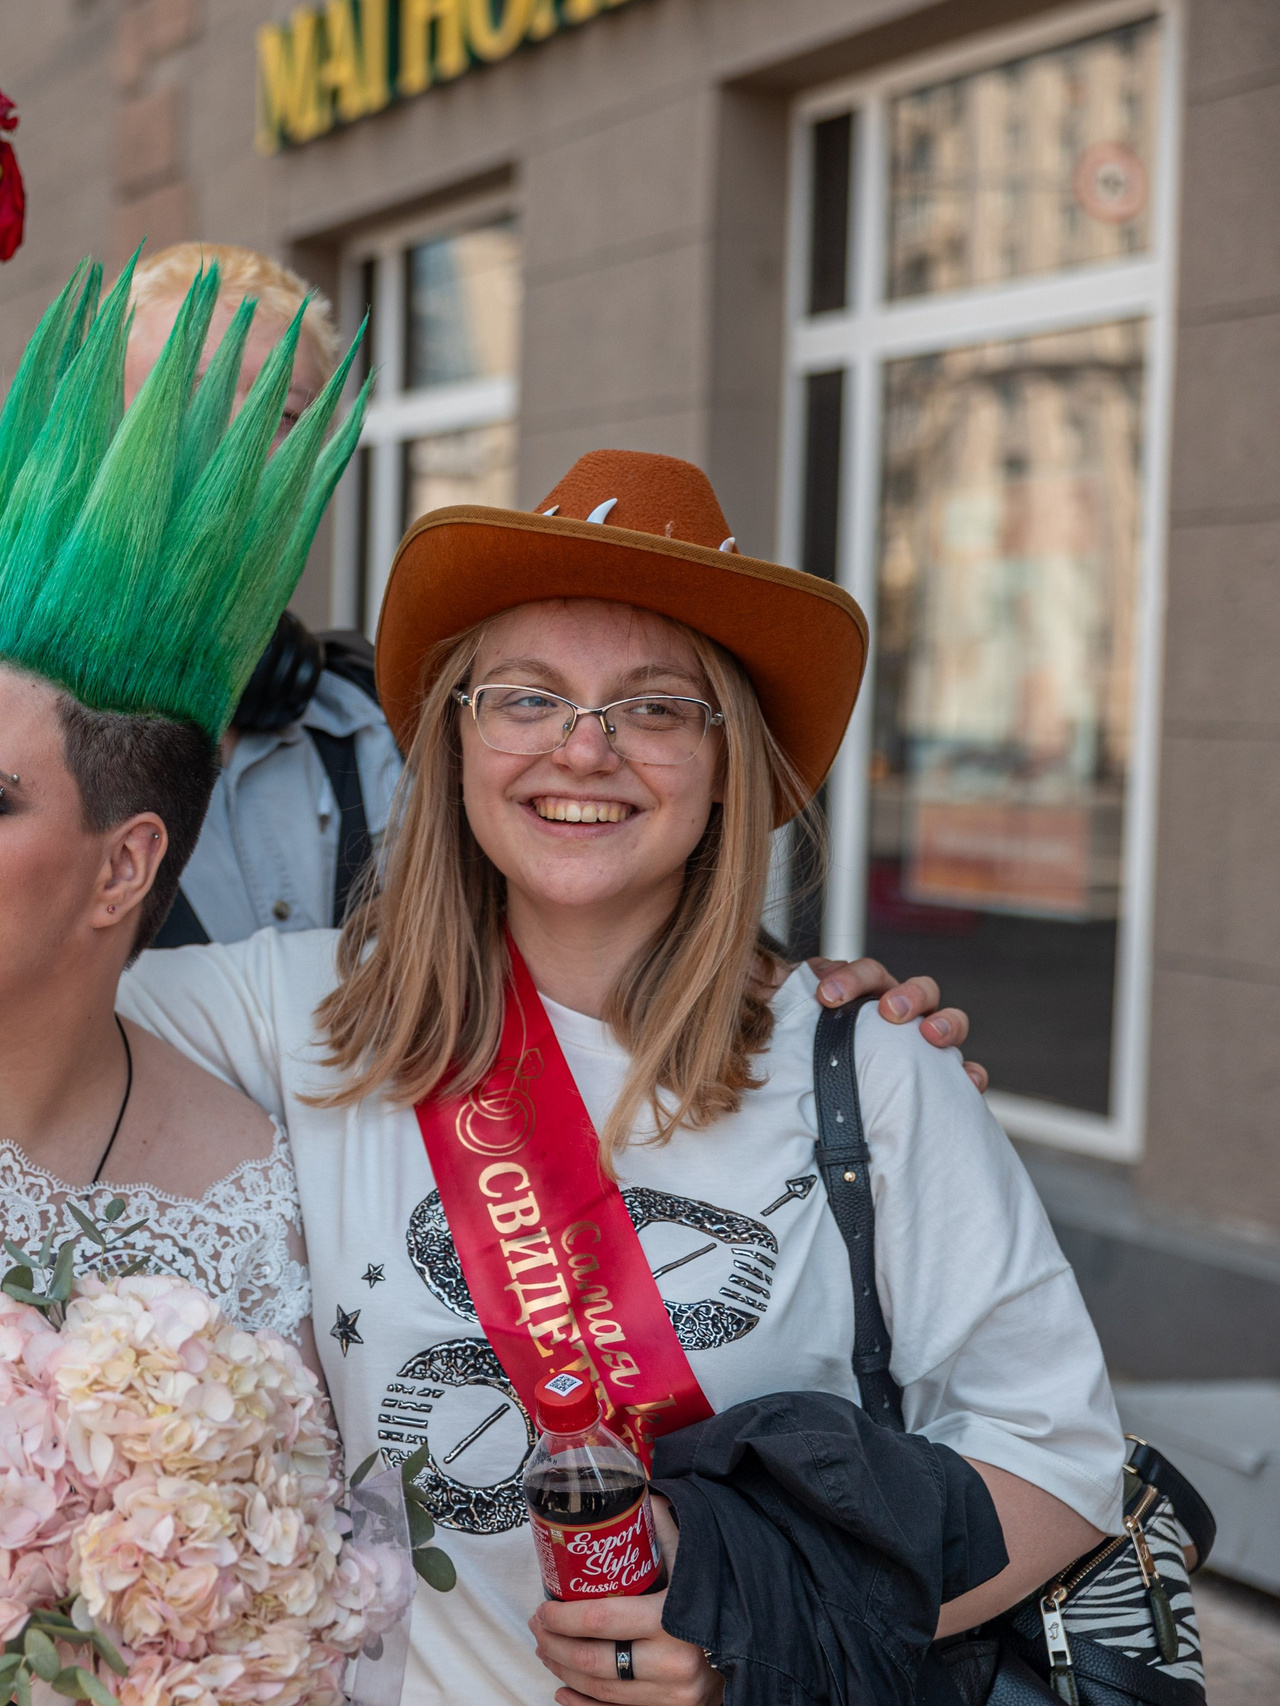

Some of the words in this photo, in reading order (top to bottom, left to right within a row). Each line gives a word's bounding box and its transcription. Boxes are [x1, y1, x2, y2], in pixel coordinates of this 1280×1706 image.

[256, 0, 626, 156] МАГН
[567, 1506, 642, 1564] Export
[570, 1577, 618, 1593] Classic
[621, 1560, 652, 1586] Cola
[582, 1544, 639, 1580] Style
